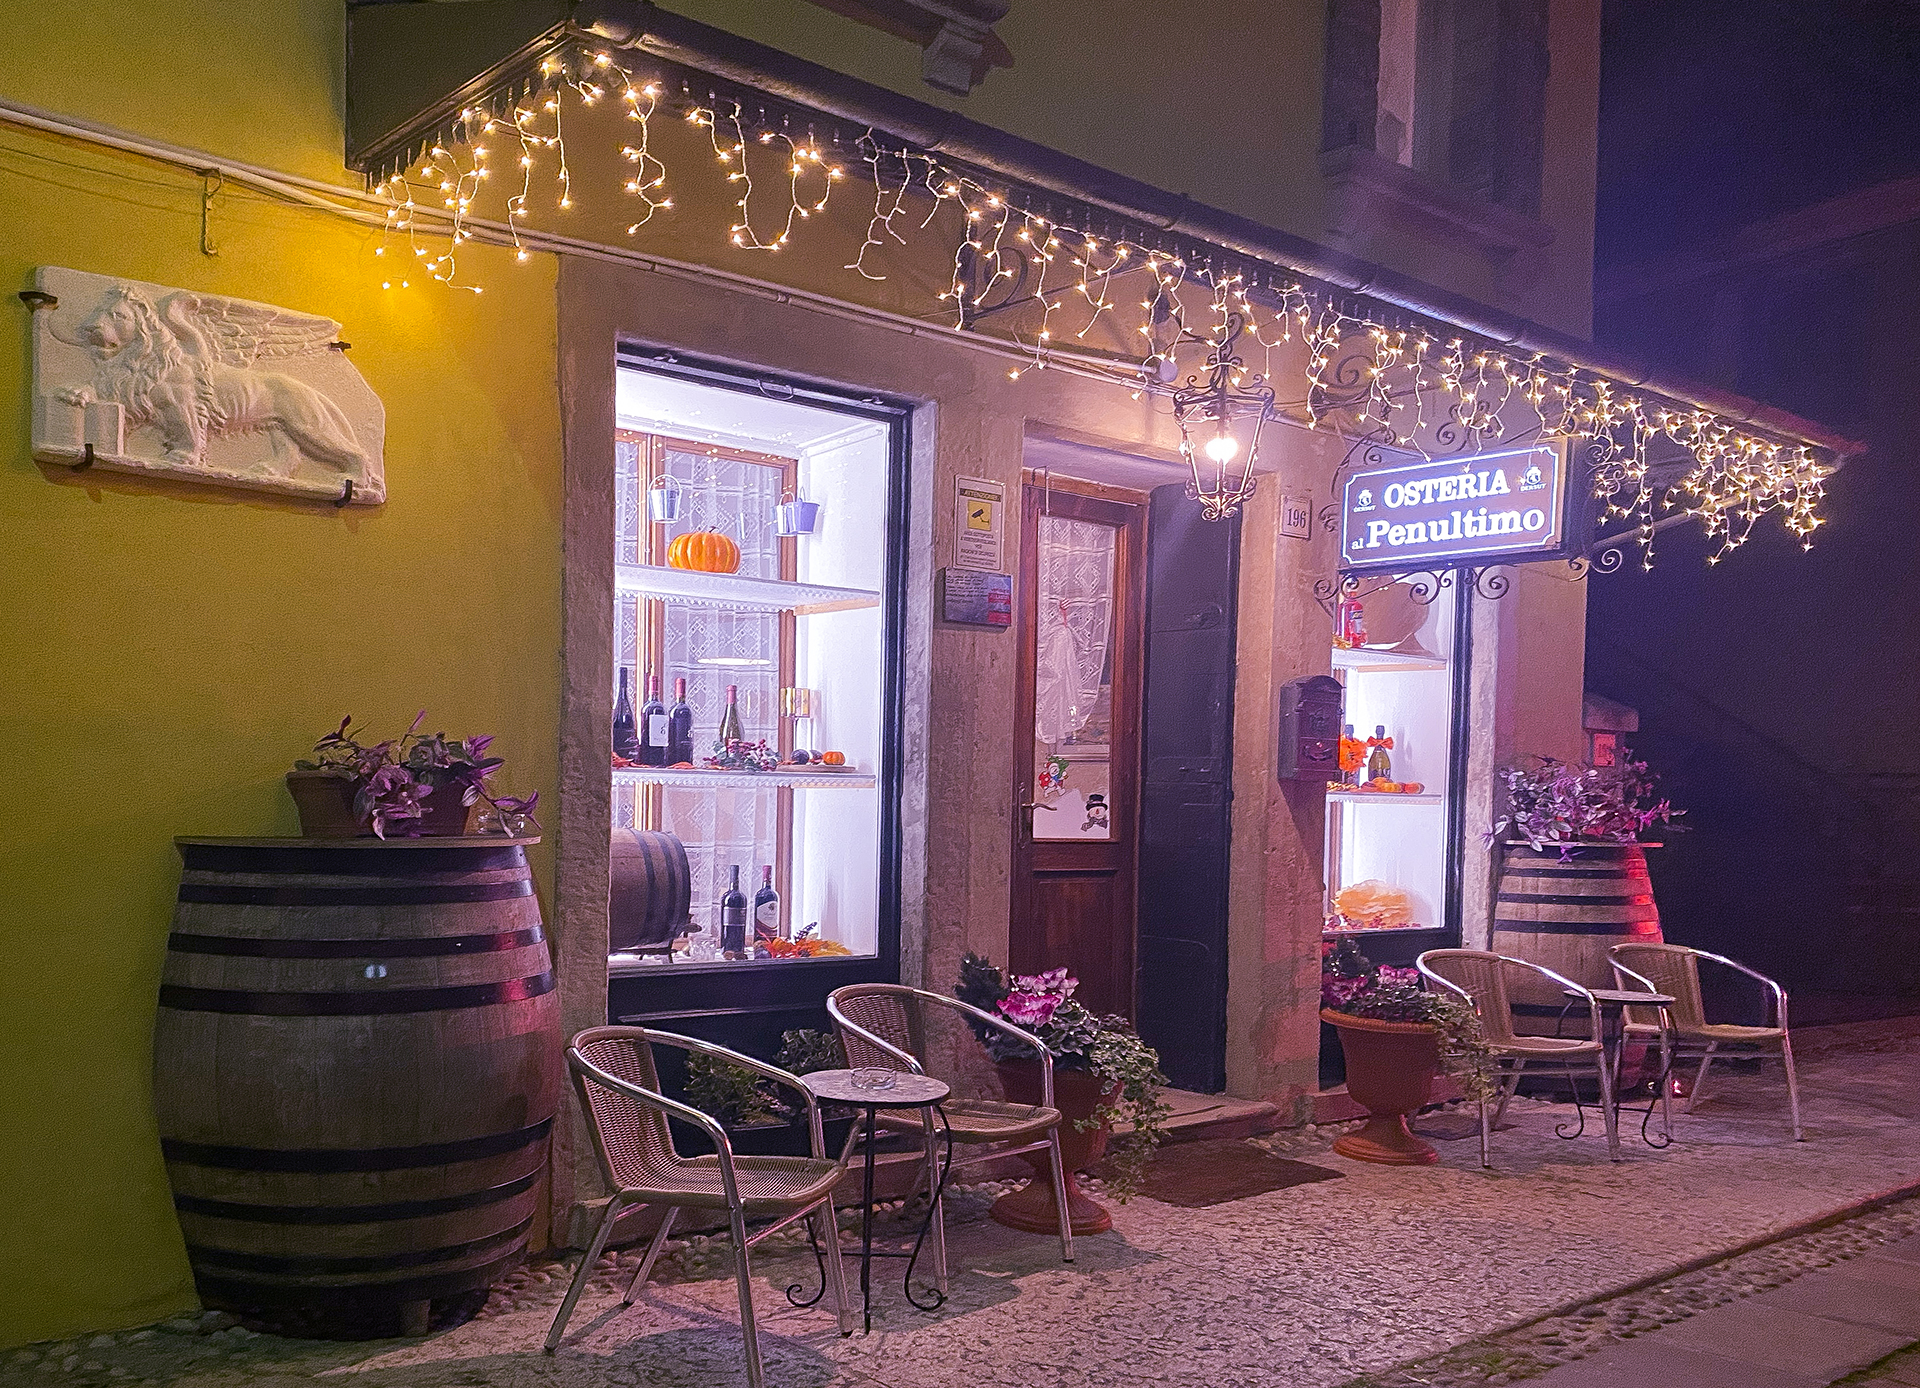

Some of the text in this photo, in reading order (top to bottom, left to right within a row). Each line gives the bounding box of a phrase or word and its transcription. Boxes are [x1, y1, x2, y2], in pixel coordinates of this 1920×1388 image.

[1383, 469, 1511, 509] OSTERIA
[1287, 508, 1306, 528] 196
[1351, 507, 1545, 550] al Penultimo
